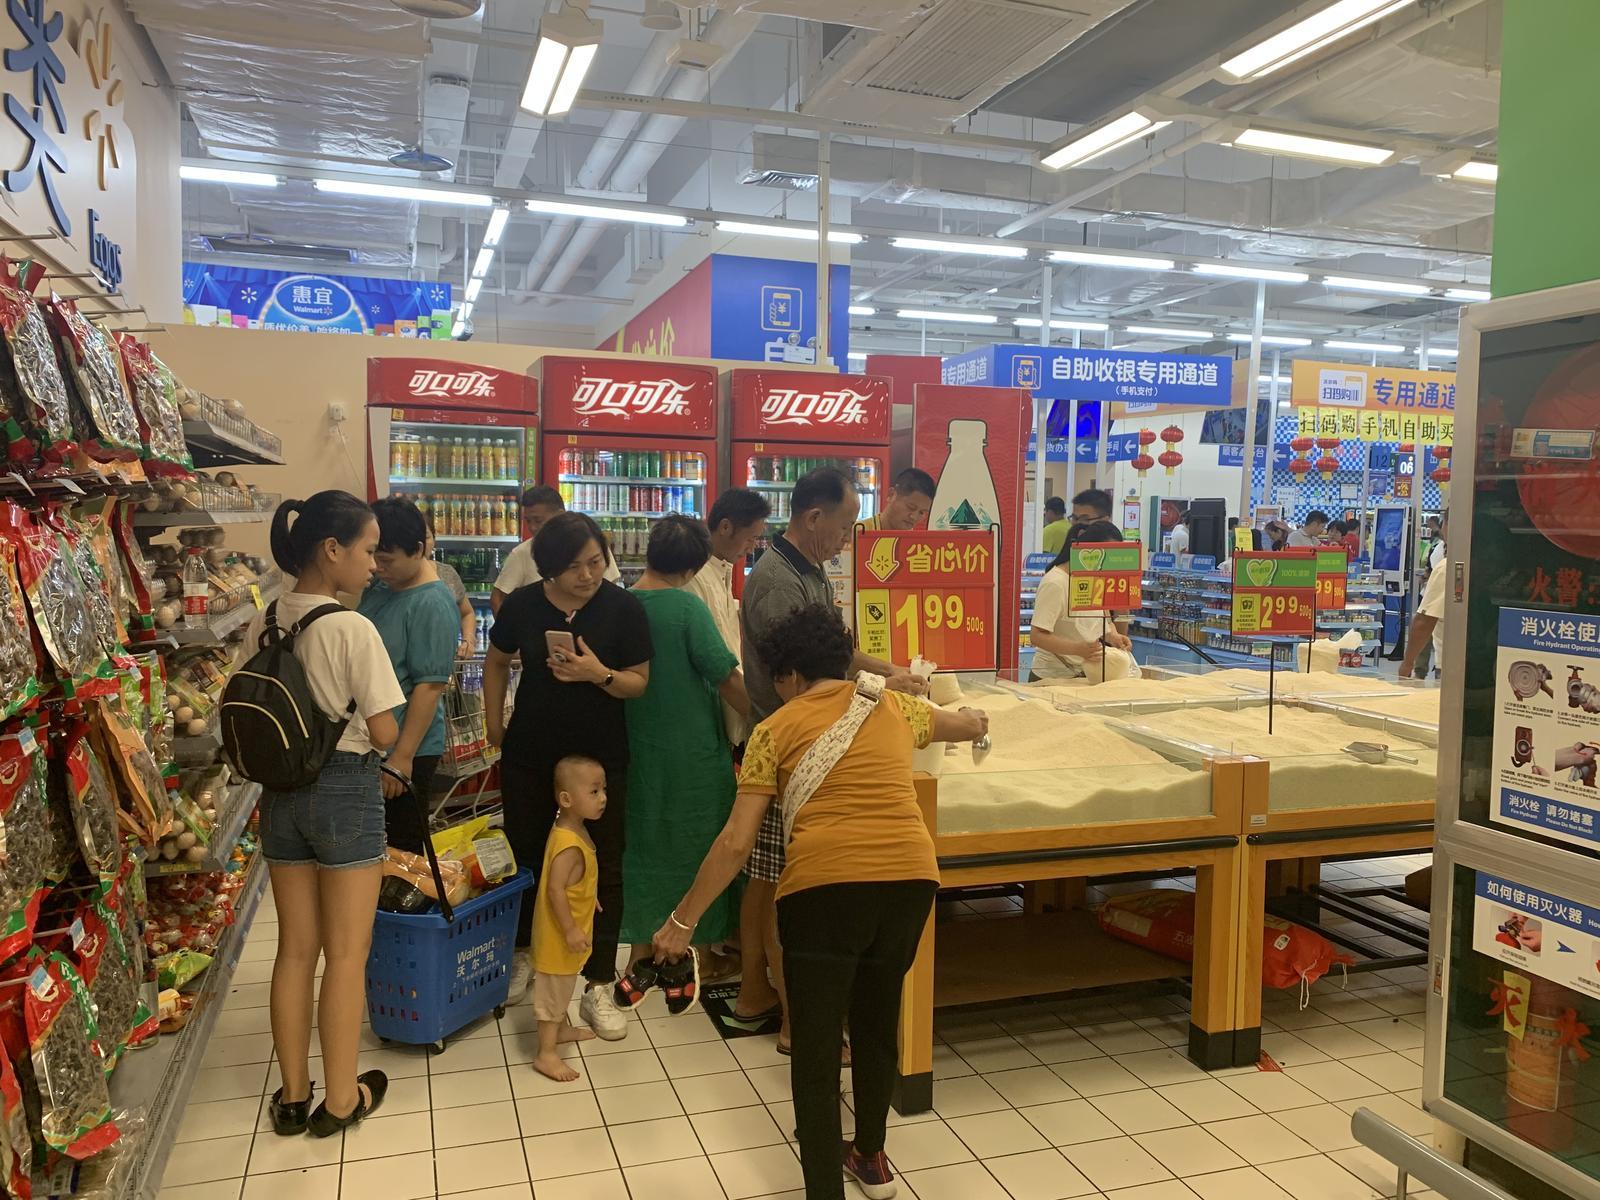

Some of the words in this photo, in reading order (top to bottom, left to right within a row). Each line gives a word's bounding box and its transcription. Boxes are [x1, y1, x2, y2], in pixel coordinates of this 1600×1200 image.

[88, 208, 122, 293] Eggs
[292, 285, 333, 305] 惠宜
[293, 305, 323, 314] Walmart
[408, 370, 499, 397] 可口可乐
[1052, 355, 1218, 387] 自助收银专用通道
[572, 378, 696, 417] 可口可乐
[761, 388, 873, 425] 可口可乐
[1400, 461, 1414, 474] 06
[906, 542, 989, 573] 省心价
[1300, 604, 1312, 619] 500g
[966, 617, 984, 636] 500g
[1520, 616, 1600, 644] 消火栓使
[1533, 639, 1545, 647] Fire
[1546, 641, 1570, 650] Hydrant
[1508, 794, 1541, 813] 消火栓
[1546, 803, 1594, 827] 请勿堵塞
[1487, 880, 1583, 925] 如何使用灭火器
[457, 936, 496, 964] Walmart
[457, 951, 495, 978] 沃尔玛
